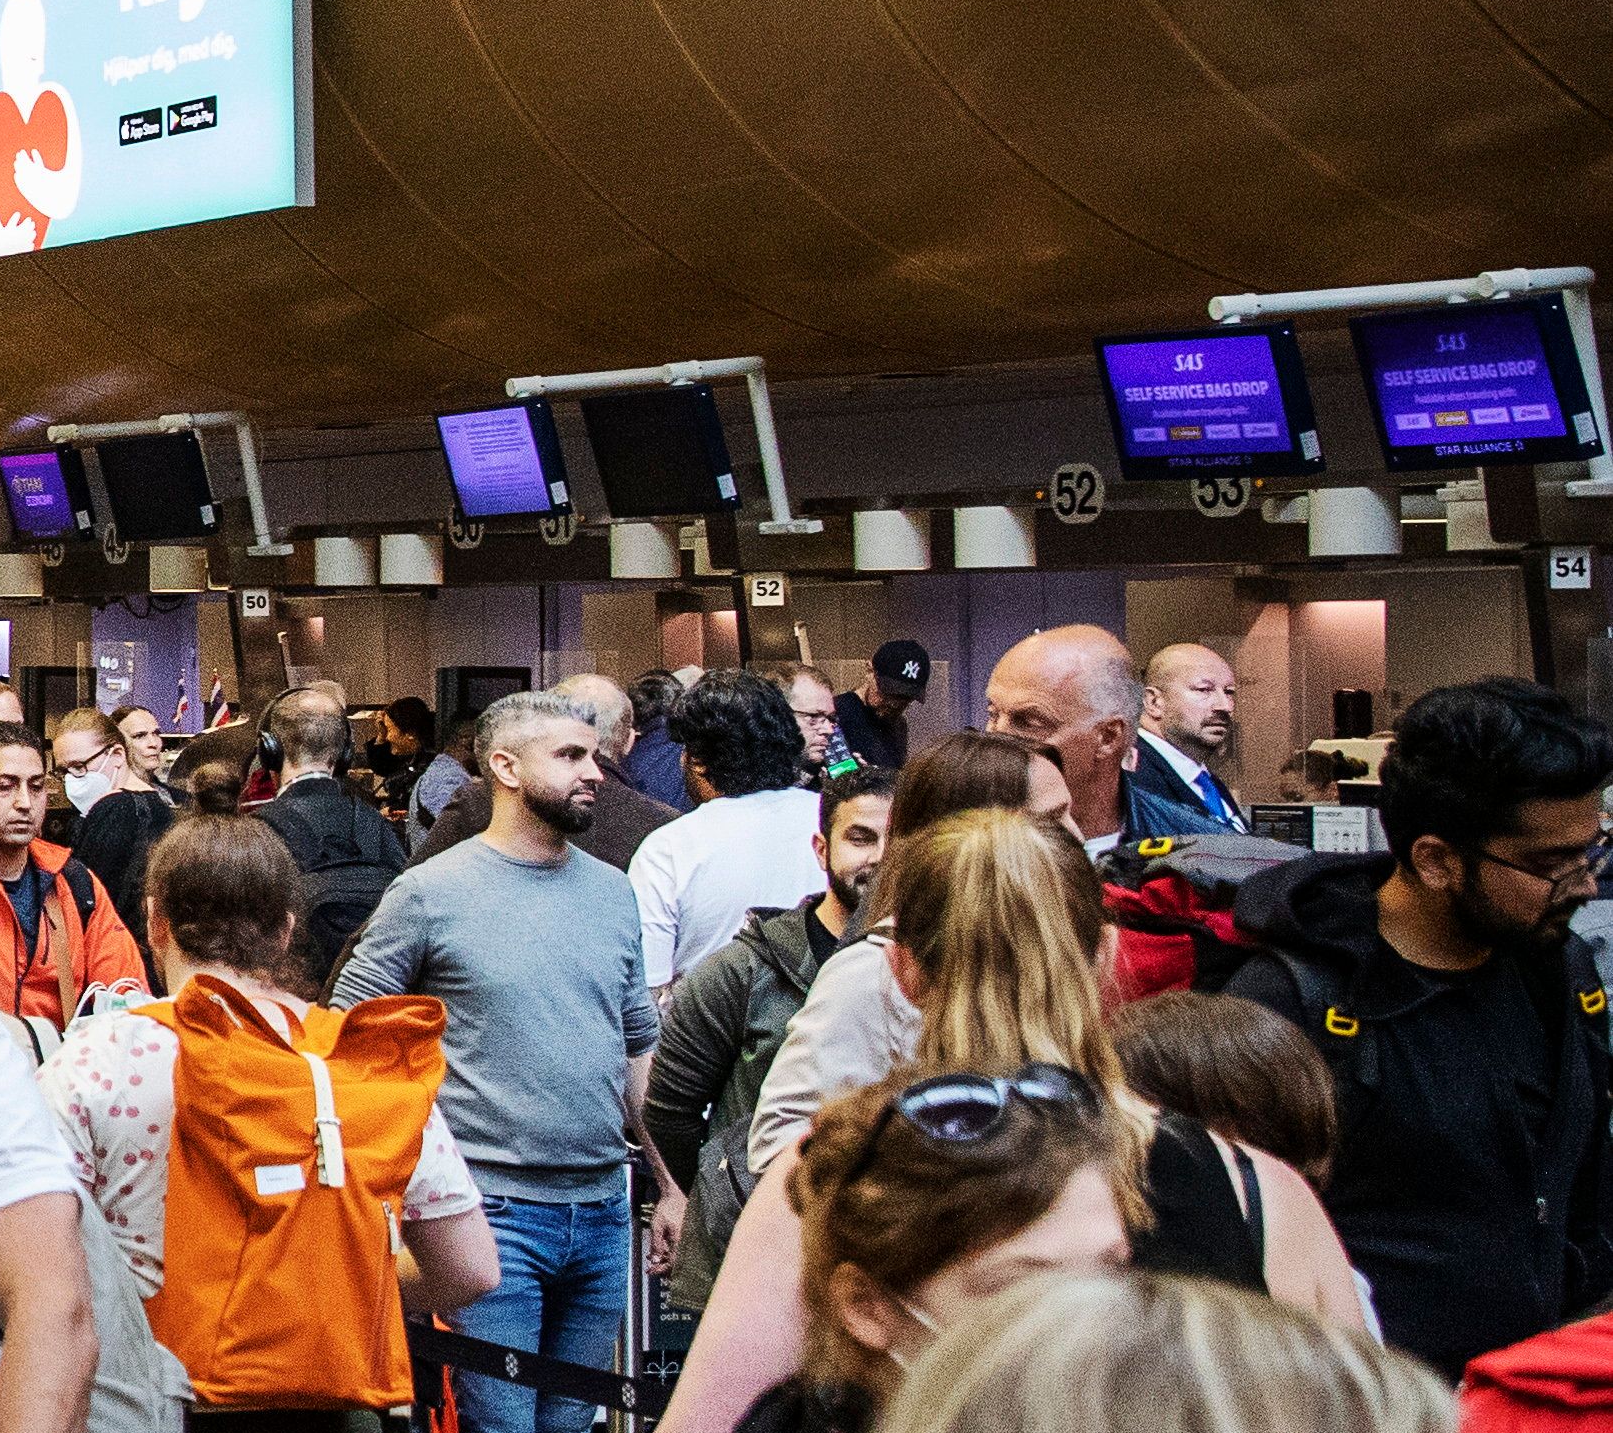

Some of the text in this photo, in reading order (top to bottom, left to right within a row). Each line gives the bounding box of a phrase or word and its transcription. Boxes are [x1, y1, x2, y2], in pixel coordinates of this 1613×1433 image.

[1436, 332, 1467, 352] SAS
[1173, 353, 1204, 372] SAS
[1383, 360, 1537, 387] SELF SERVICE BAG DROP
[1124, 380, 1269, 402] SELF SERVICE BAG DROP
[1435, 441, 1513, 456] STAR ALLIANCE
[1055, 470, 1097, 517] 52
[1555, 556, 1587, 578] 54
[754, 579, 781, 597] 52
[245, 594, 267, 612] 50
